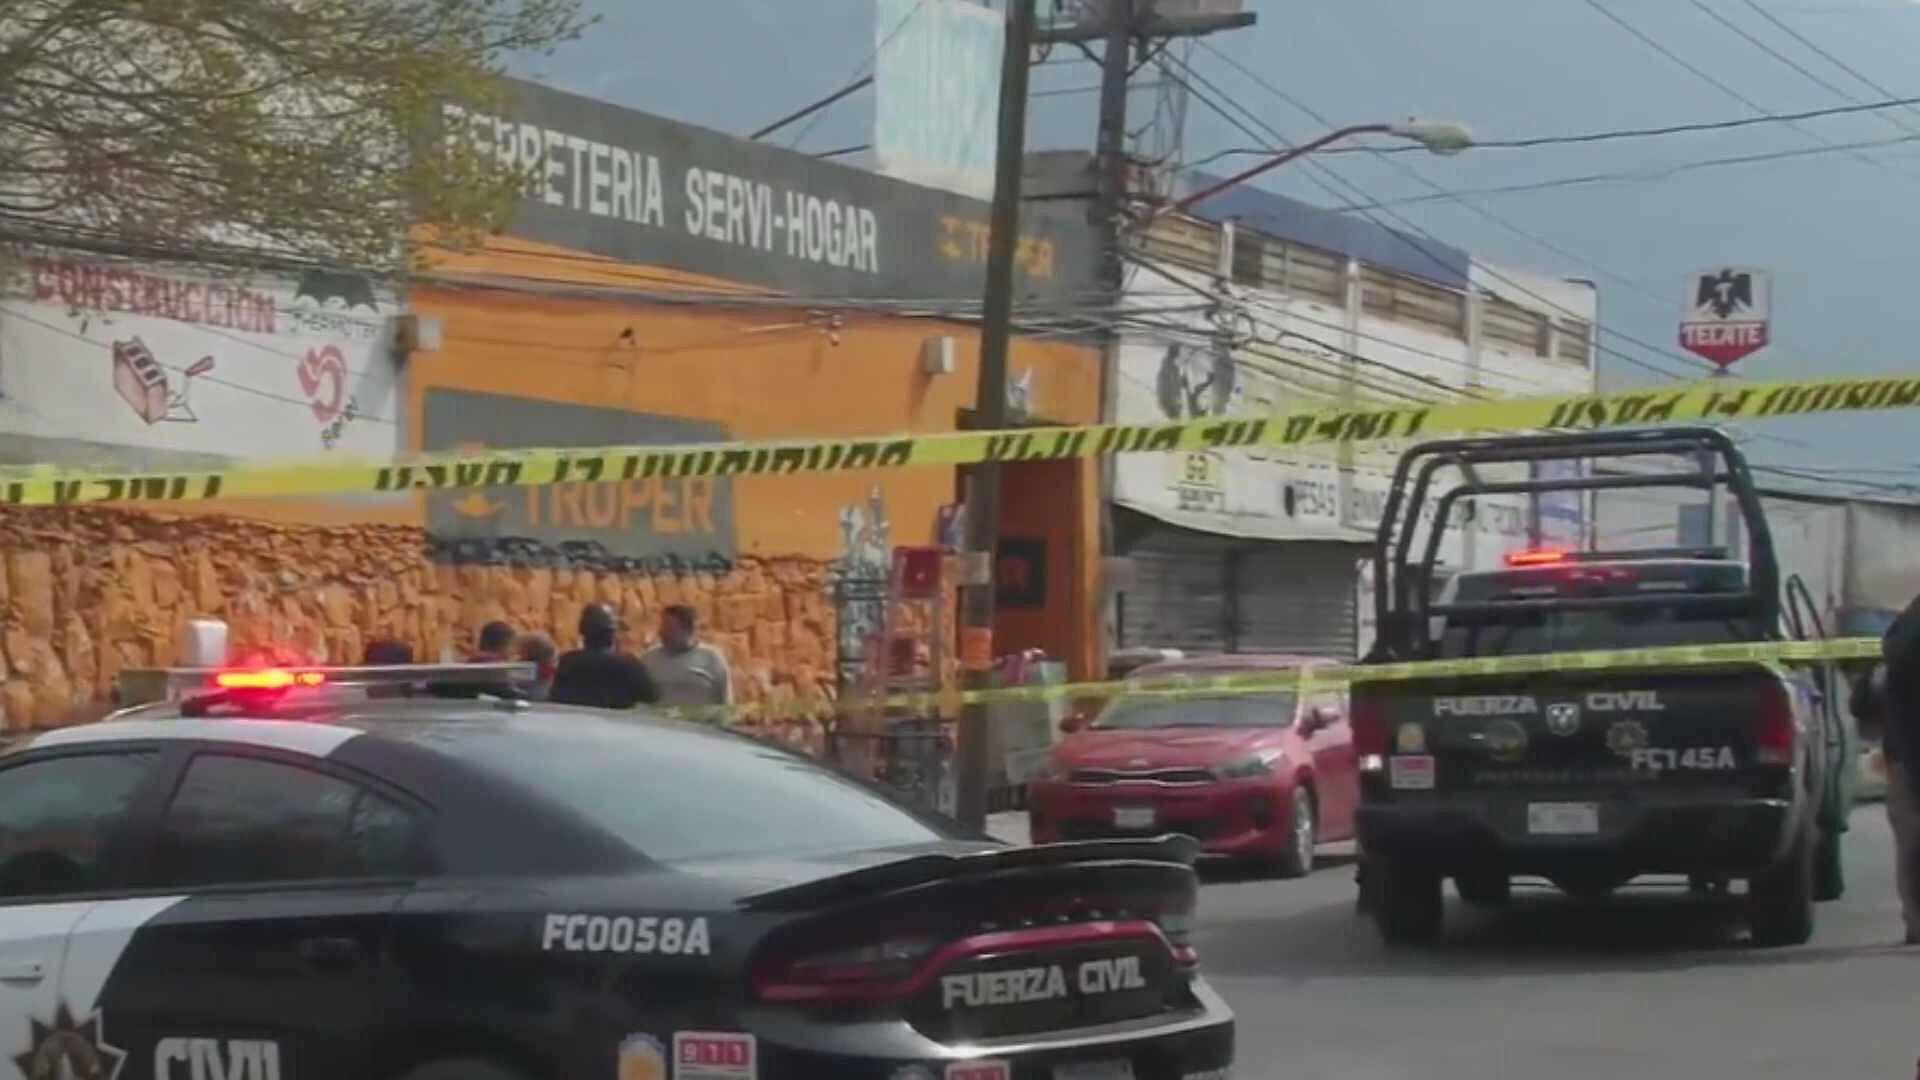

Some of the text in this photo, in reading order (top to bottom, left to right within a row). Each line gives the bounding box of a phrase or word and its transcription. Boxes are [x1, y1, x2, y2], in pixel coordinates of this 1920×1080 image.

[684, 165, 879, 273] SERVI-HOGAR
[1682, 322, 1764, 346] TECATE
[1433, 690, 1665, 716] FUERZA CIVIL
[1631, 746, 1736, 770] FC145A
[542, 913, 711, 956] FC0058A
[941, 955, 1146, 1009] FUERZA CIVIL
[682, 1041, 746, 1064] 911
